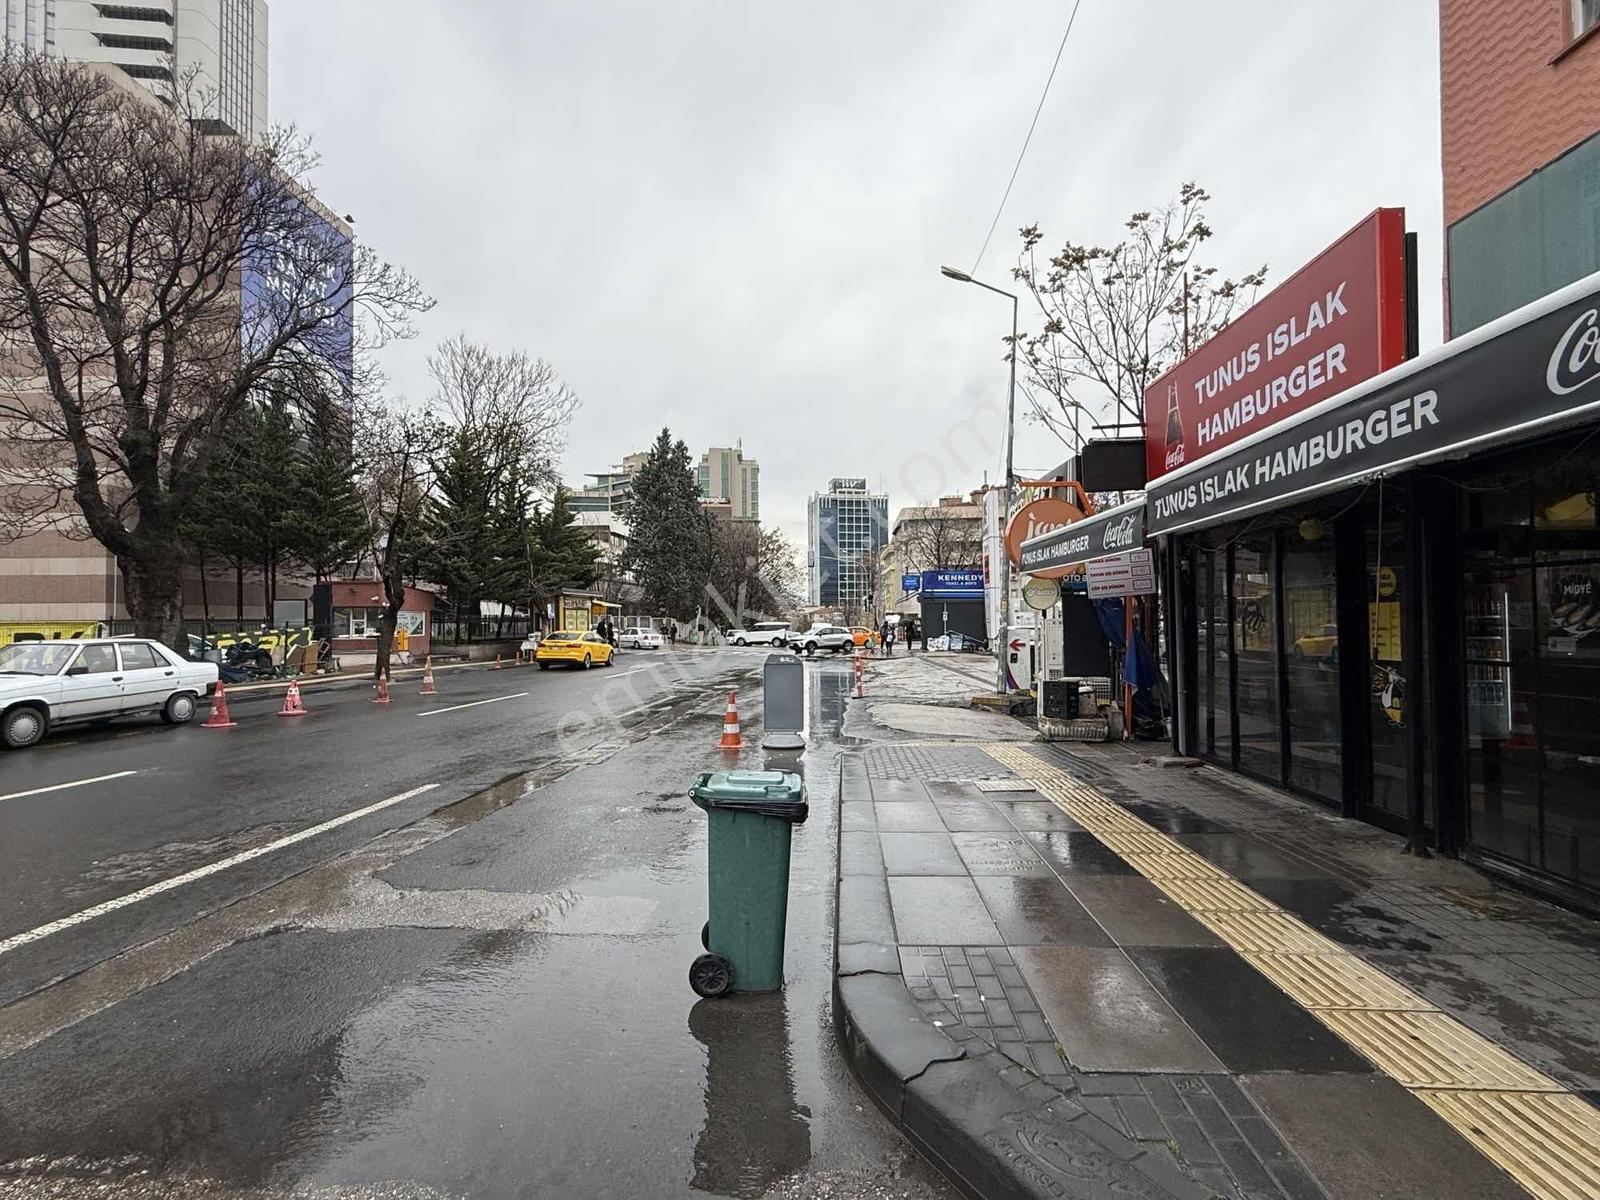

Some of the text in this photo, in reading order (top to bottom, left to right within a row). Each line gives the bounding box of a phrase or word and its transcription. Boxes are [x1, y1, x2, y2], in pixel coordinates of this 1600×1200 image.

[1194, 281, 1348, 404] TUNUS ISLAK
[1546, 308, 1600, 395] Co
[1197, 342, 1348, 447] HAMBURGER
[1154, 389, 1440, 520] TUNUS ISLAK HAMBURGER
[1051, 535, 1090, 559] HAMBURGER
[1062, 574, 1081, 582] OTO
